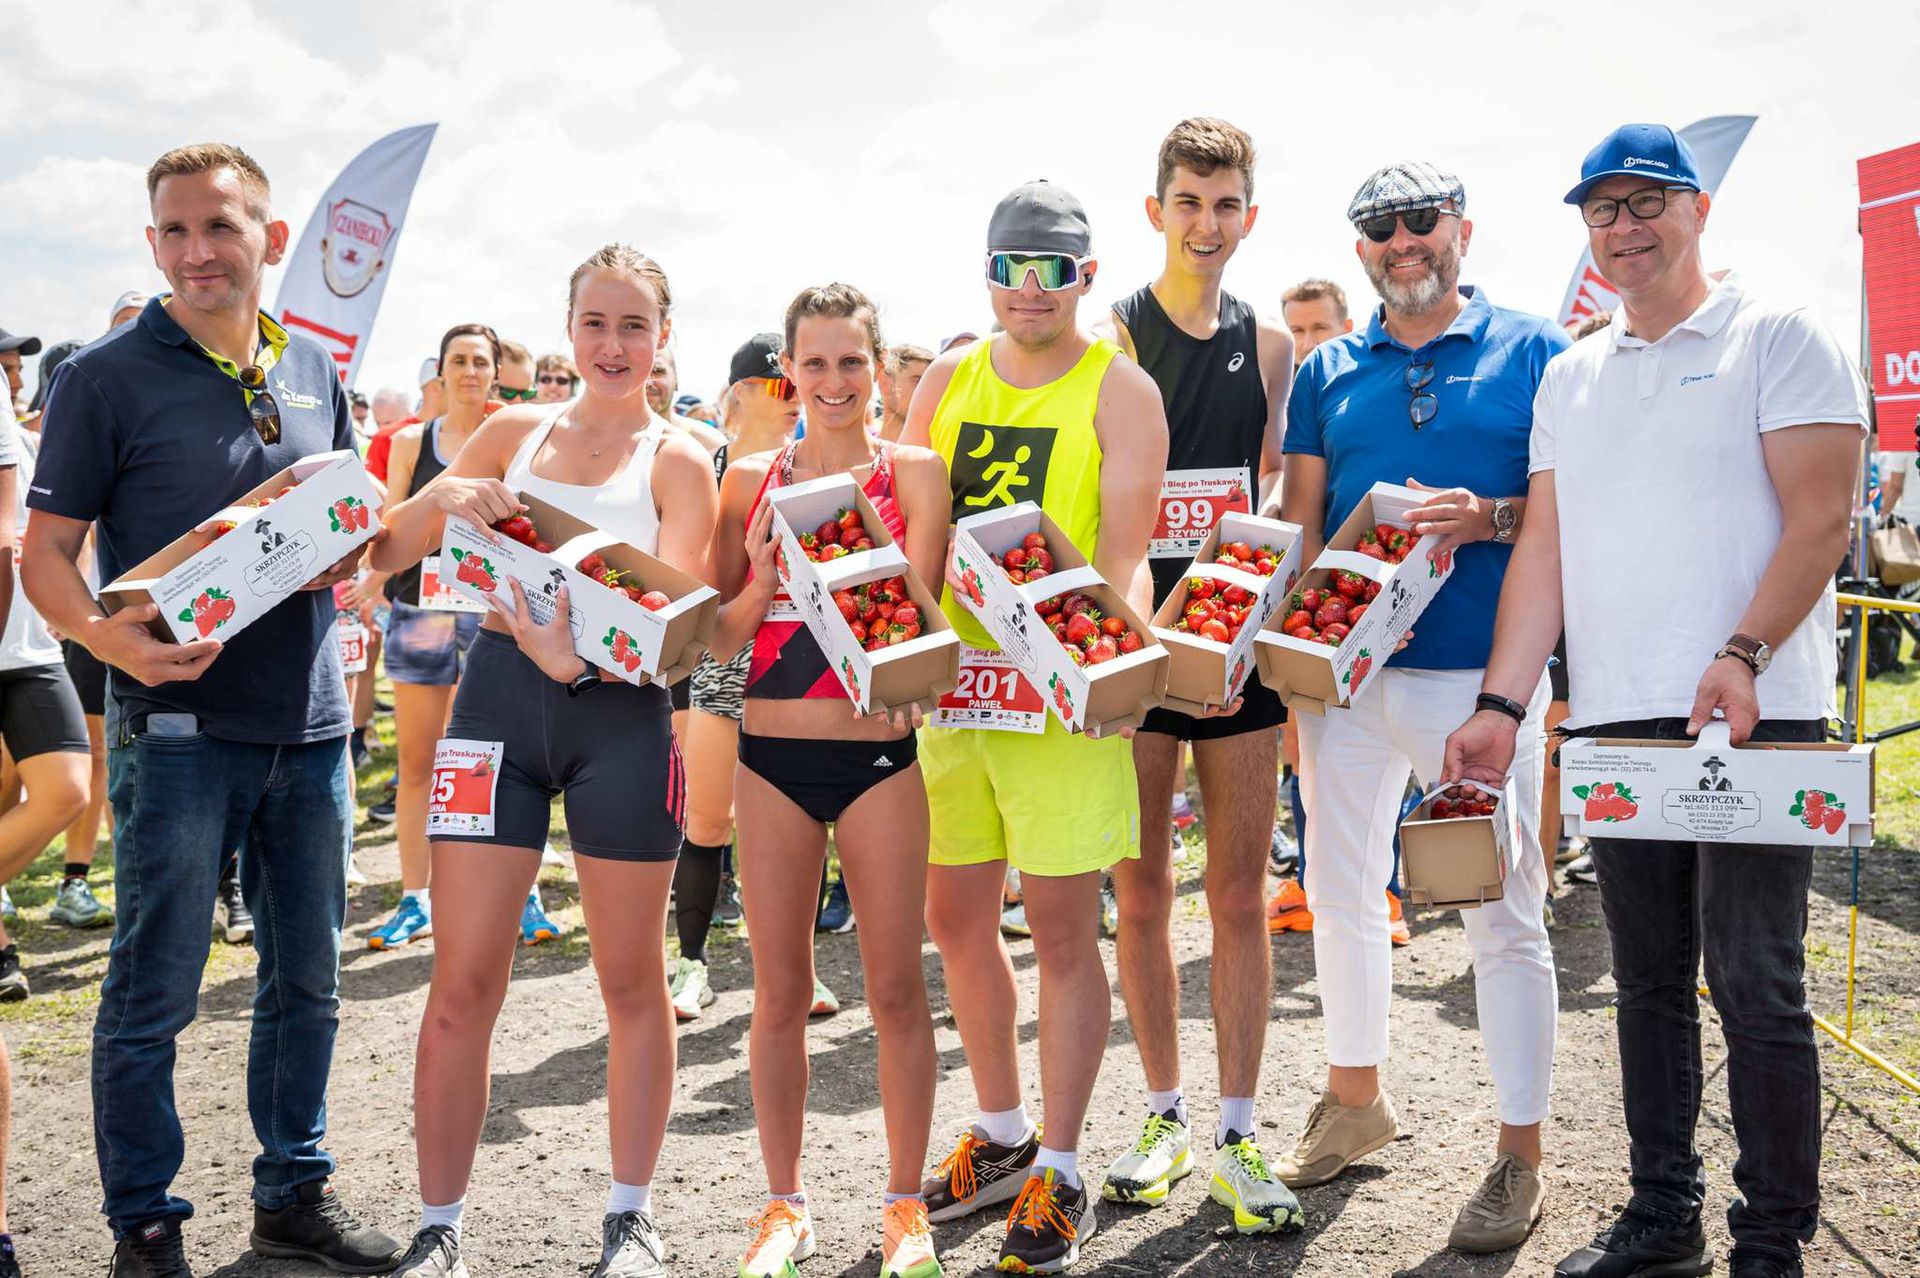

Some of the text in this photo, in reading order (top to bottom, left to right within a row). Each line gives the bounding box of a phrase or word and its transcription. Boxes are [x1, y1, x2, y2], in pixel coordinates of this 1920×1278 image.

[1165, 499, 1213, 529] 99
[254, 539, 301, 575] SKRZYPCZYK
[526, 589, 575, 618] SKRZYPK
[953, 669, 1019, 700] 201
[968, 699, 1003, 709] PAWEŁ
[1678, 794, 1744, 805] SKRZYPCZYK
